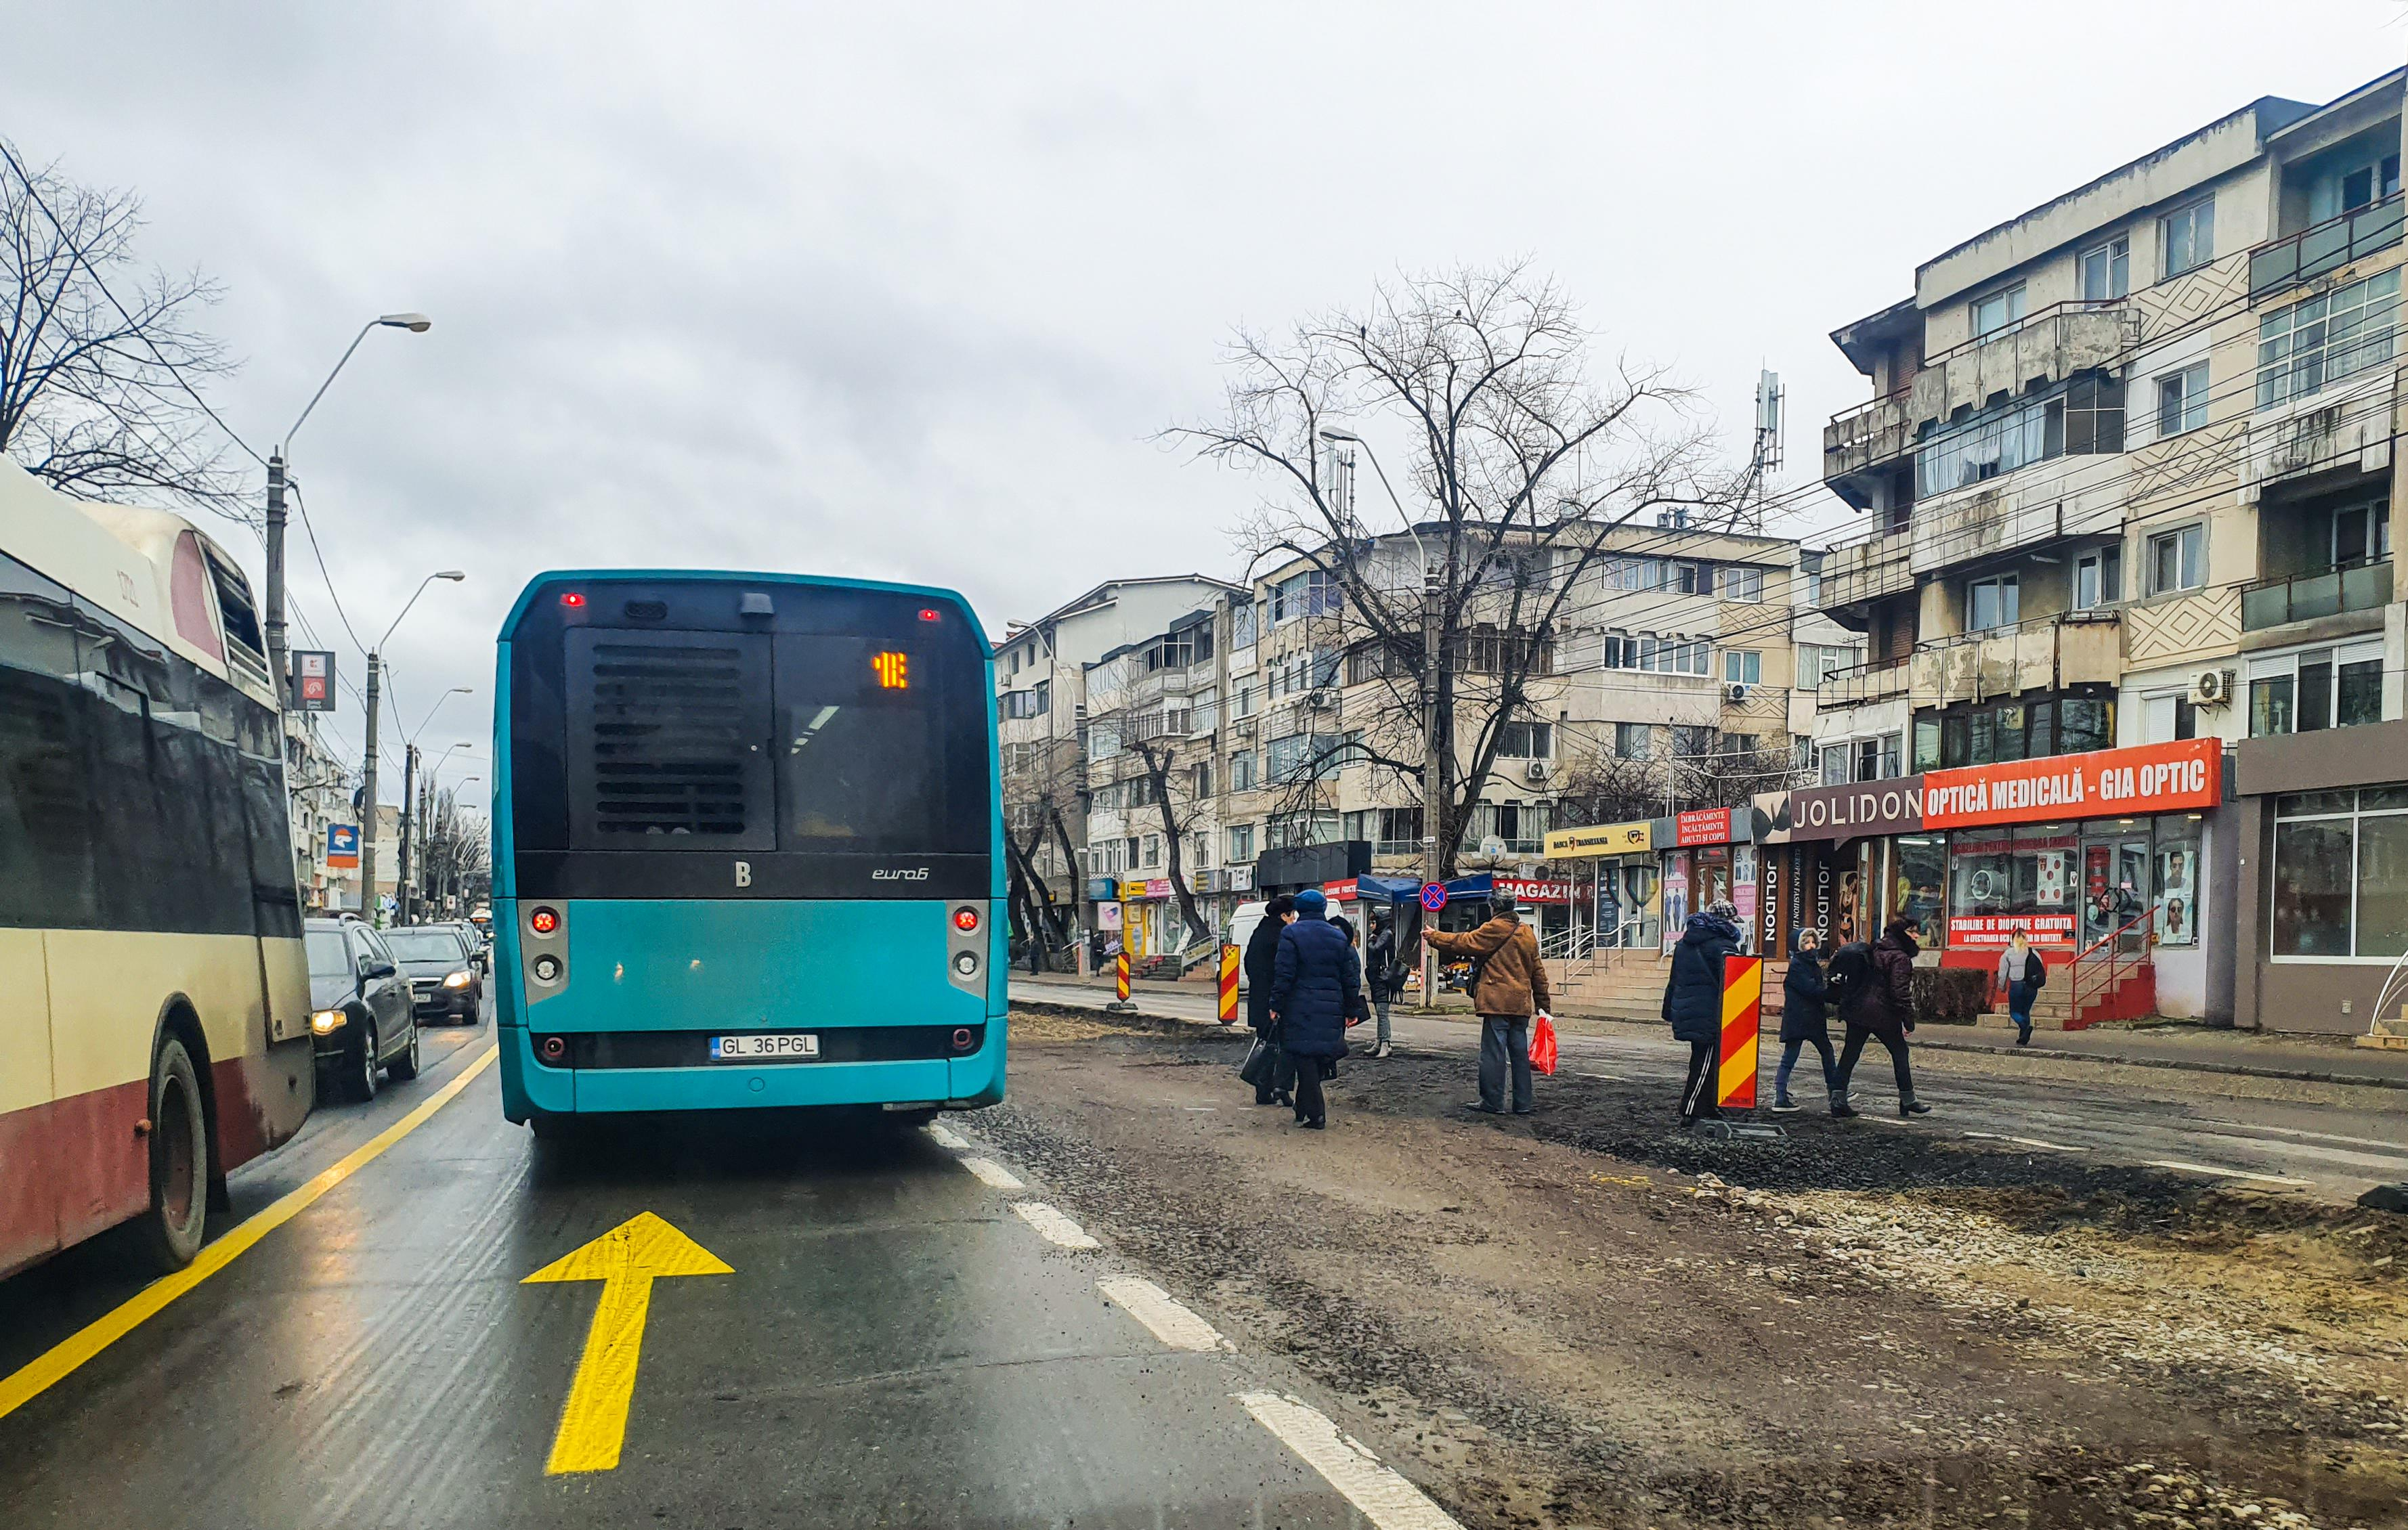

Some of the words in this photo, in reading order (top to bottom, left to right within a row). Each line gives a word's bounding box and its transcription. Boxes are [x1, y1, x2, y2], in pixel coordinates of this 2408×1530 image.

[1927, 777, 1988, 816] OPTICĂ
[1992, 766, 2084, 810] MEDICALĂ
[2100, 766, 2136, 800] GIA
[2140, 759, 2205, 797] OPTIC
[1794, 788, 1923, 829] JOLIDON
[1709, 832, 1725, 841] COPII
[735, 861, 752, 887] B
[872, 867, 930, 881] euro6
[1765, 860, 1777, 941] JOLIDON
[1818, 860, 1830, 941] JOLIDON
[1950, 919, 1983, 931] STABILIRE
[1986, 919, 1995, 930] DE
[1998, 918, 2031, 931] DIOPTRIE
[2034, 917, 2072, 930] GRATUITA
[1964, 934, 1970, 942] LA
[723, 1039, 746, 1054] GL
[754, 1038, 775, 1053] 36
[778, 1036, 815, 1053] PGL
